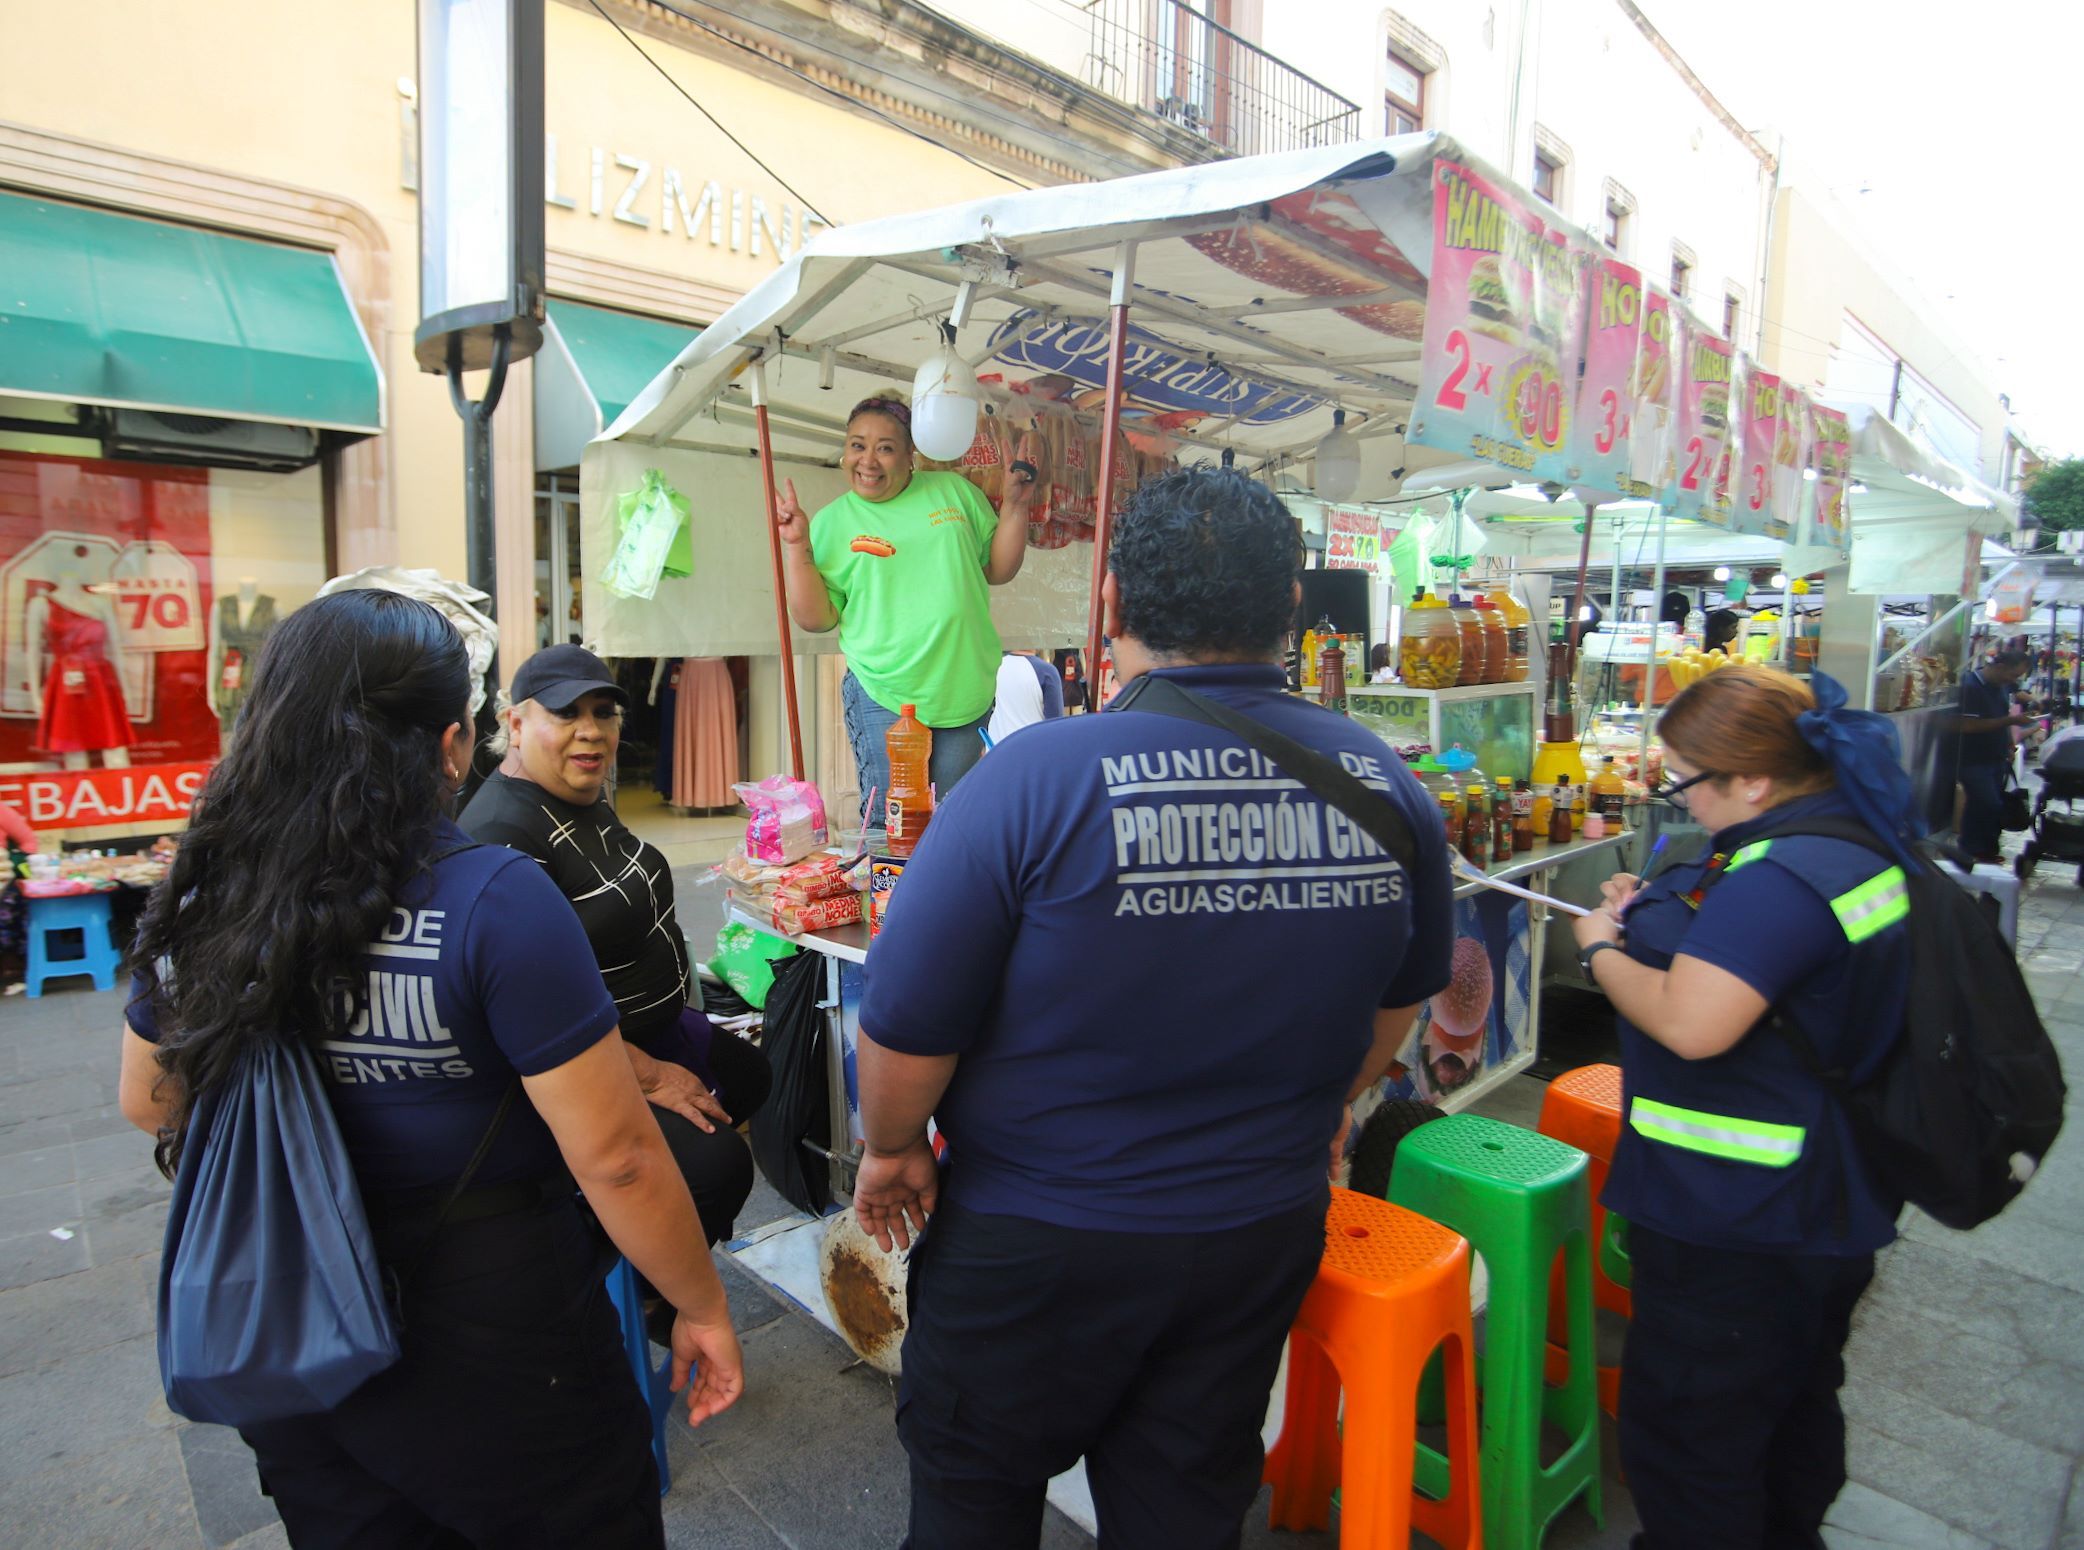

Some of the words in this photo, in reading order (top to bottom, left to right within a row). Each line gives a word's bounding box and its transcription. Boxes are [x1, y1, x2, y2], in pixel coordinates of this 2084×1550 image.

[1434, 330, 1470, 412] 2
[1595, 388, 1616, 453] 3
[1681, 437, 1702, 490] 2
[1339, 751, 1388, 782] DE
[1112, 792, 1322, 868] PROTECCIÓN
[1114, 875, 1403, 917] AGUASCALIENTES
